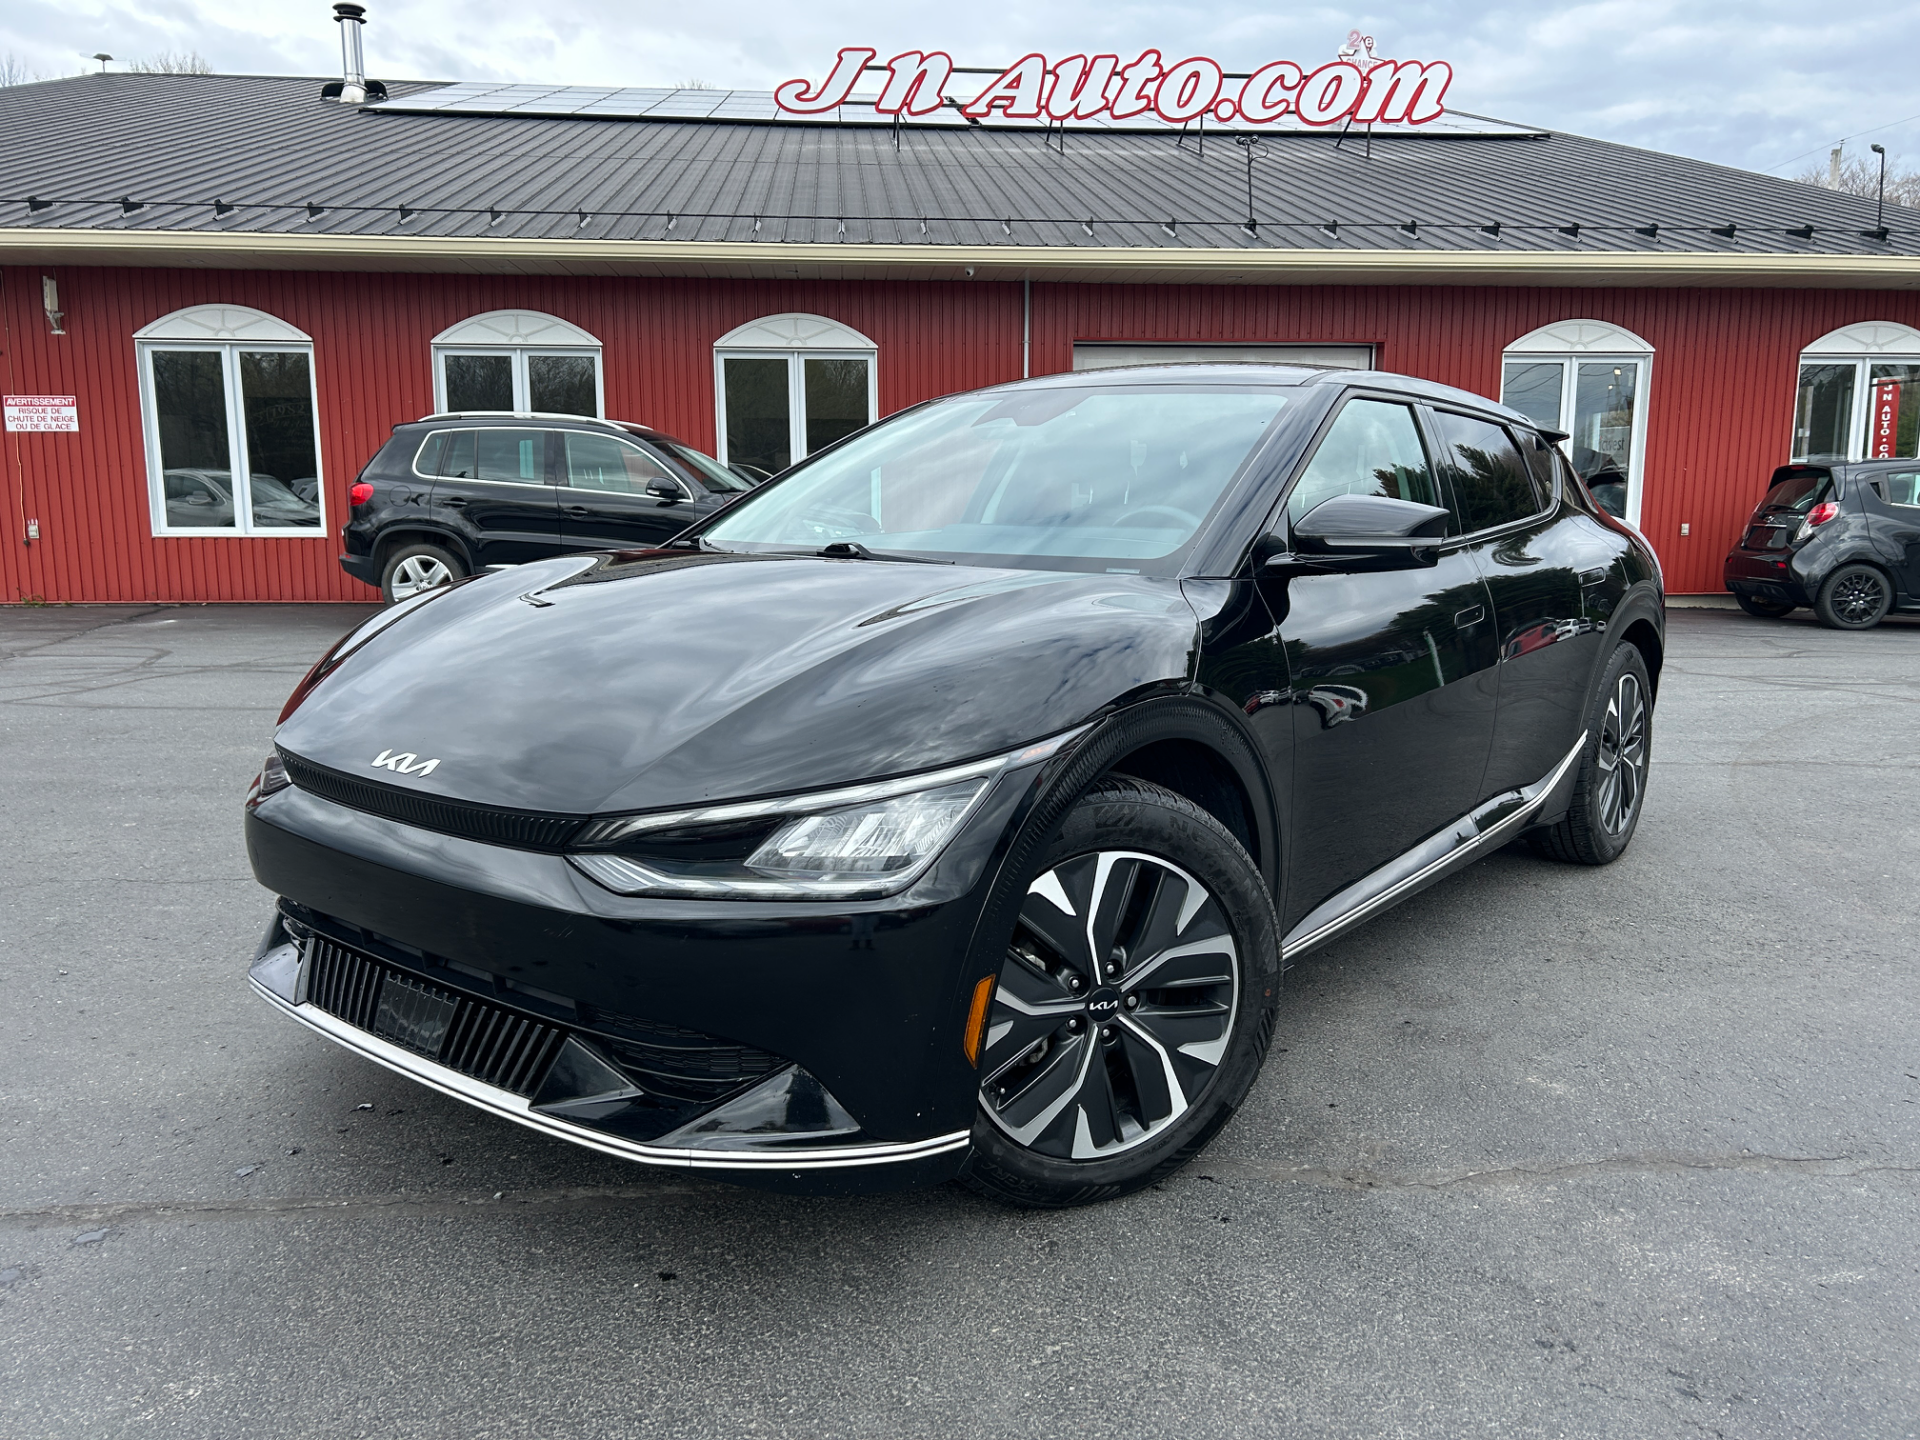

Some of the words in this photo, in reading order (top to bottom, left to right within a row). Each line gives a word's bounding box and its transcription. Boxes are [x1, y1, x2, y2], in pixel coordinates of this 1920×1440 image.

[961, 48, 1453, 126] Auto.com
[6, 397, 74, 406] AVERTISSEMENT
[18, 407, 49, 415] RISQUE
[50, 407, 63, 415] DE
[7, 415, 35, 423] CHUTE
[36, 415, 48, 423] DE
[50, 415, 75, 423] NEIGE
[15, 423, 28, 431] OU
[30, 423, 42, 431] DE
[43, 423, 72, 431] GLACE
[370, 748, 442, 778] KIA
[1089, 1000, 1119, 1011] KIA
